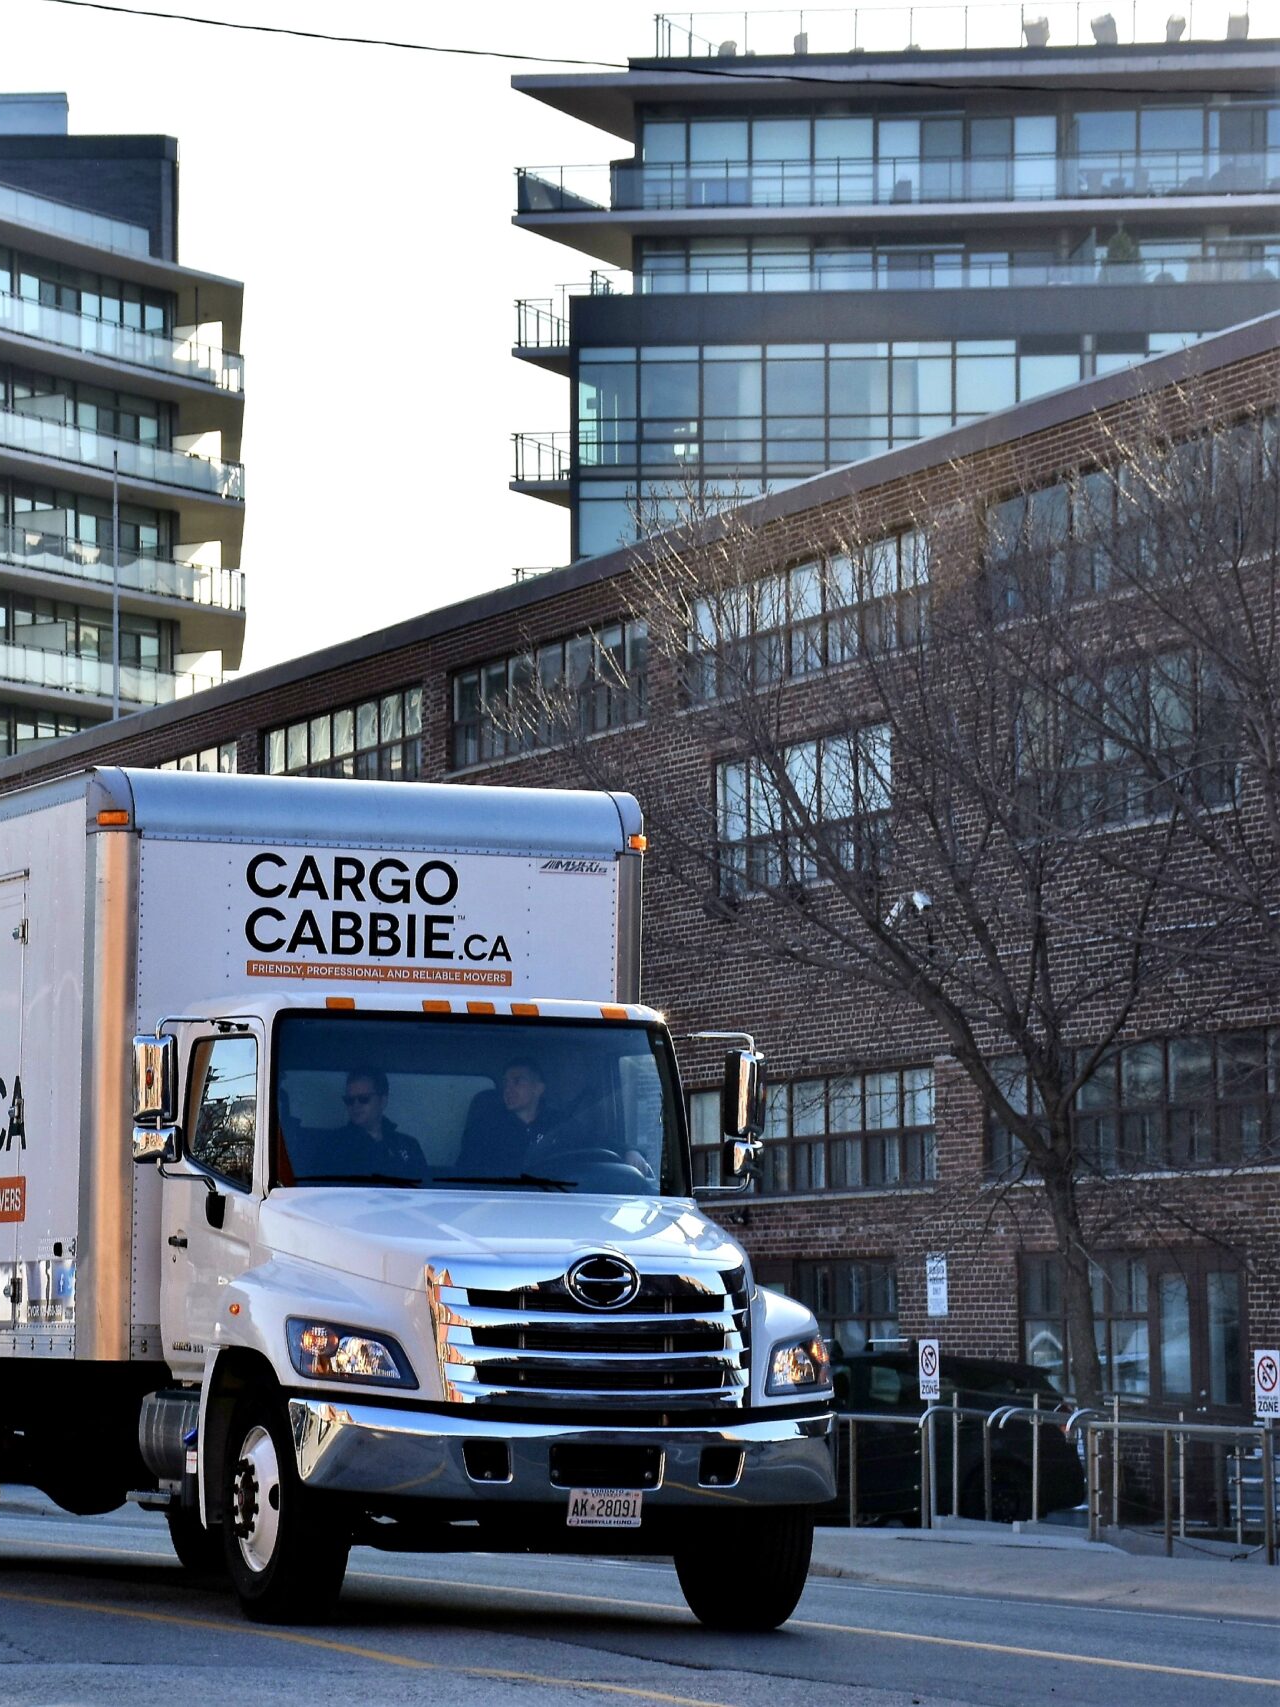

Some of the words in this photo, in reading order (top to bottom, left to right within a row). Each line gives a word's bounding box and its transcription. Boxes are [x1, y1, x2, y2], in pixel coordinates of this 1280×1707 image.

[245, 852, 459, 906] CARGO
[252, 963, 305, 976] FRIENDLY,
[306, 965, 385, 978] PROFESSIONAL
[387, 968, 410, 979] AND
[412, 969, 461, 982] RELIABLE
[463, 972, 507, 984] MOVERS
[922, 1384, 938, 1395] ZONE
[1258, 1400, 1279, 1413] ZONE
[572, 1499, 589, 1517] AK
[596, 1499, 637, 1518] 28091
